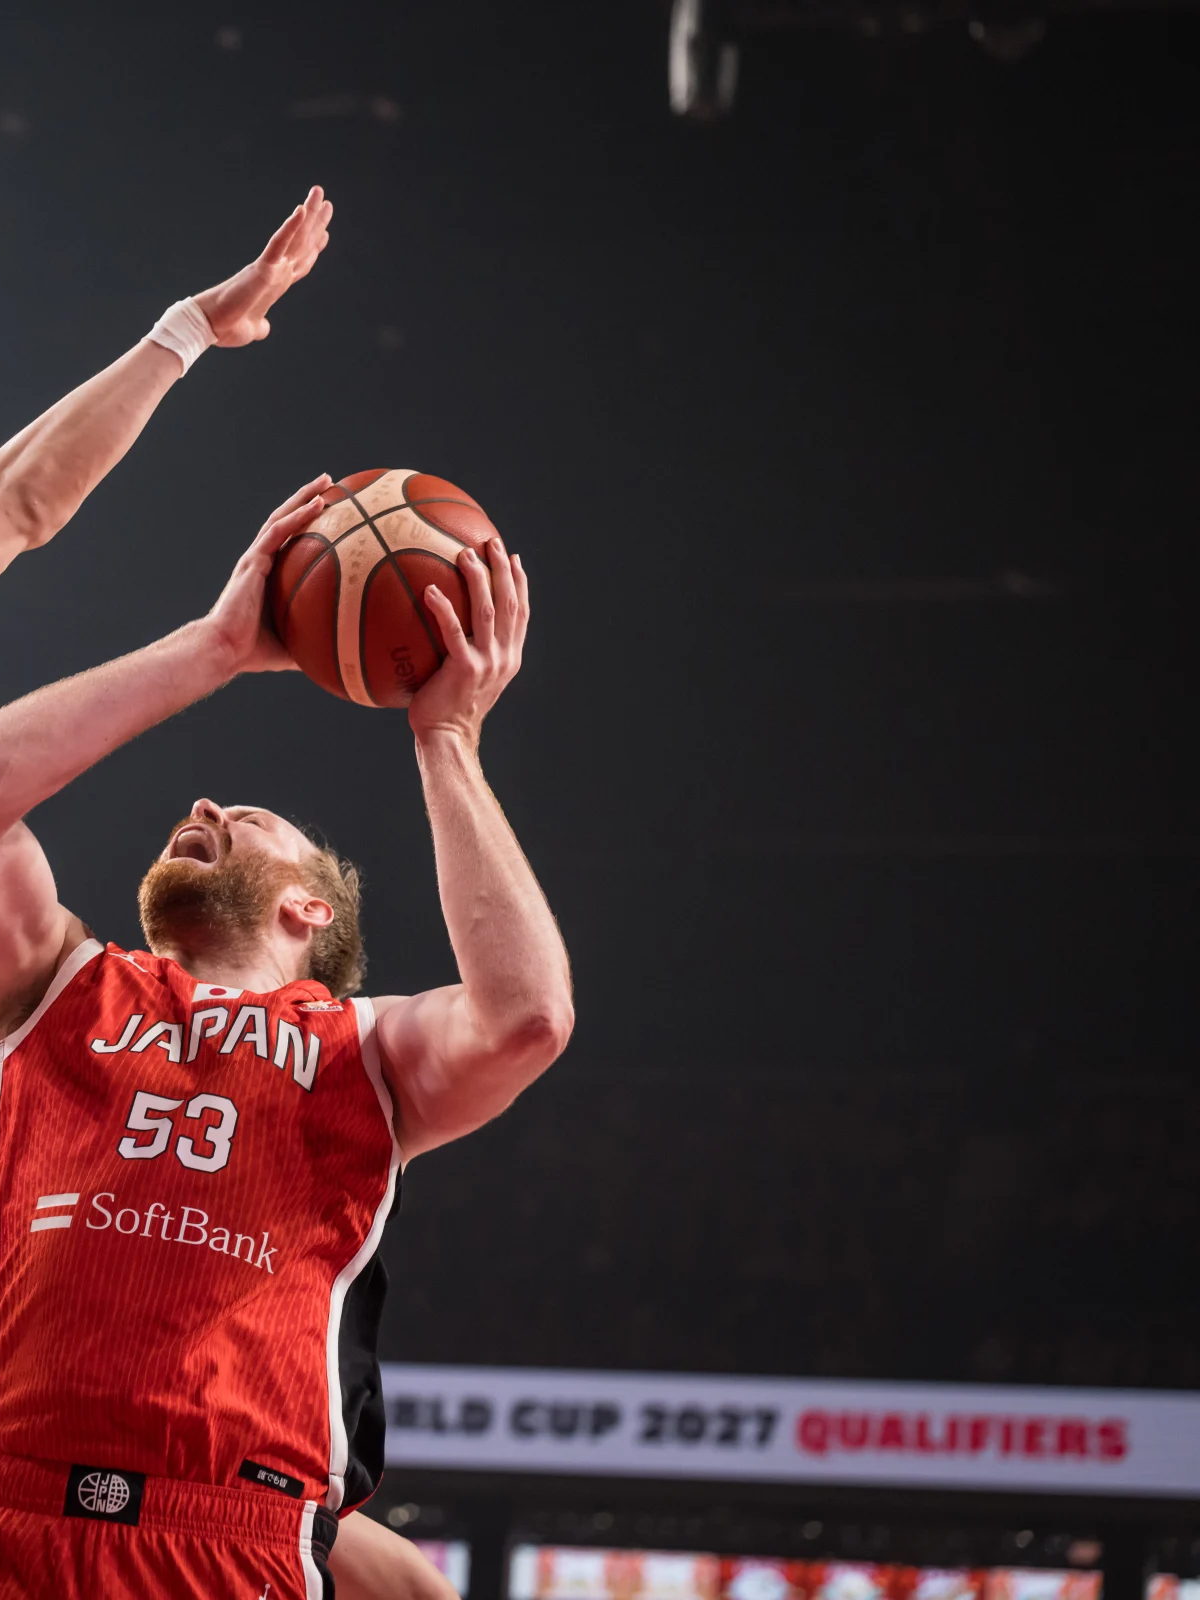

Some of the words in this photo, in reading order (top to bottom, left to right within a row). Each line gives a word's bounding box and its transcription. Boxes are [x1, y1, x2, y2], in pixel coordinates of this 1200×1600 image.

[90, 1005, 322, 1092] JAPAN
[117, 1090, 240, 1174] 53
[85, 1192, 278, 1275] SoftBank
[509, 1397, 623, 1440] CUP
[637, 1403, 780, 1448] 2027
[796, 1407, 1129, 1463] QUALIFIERS
